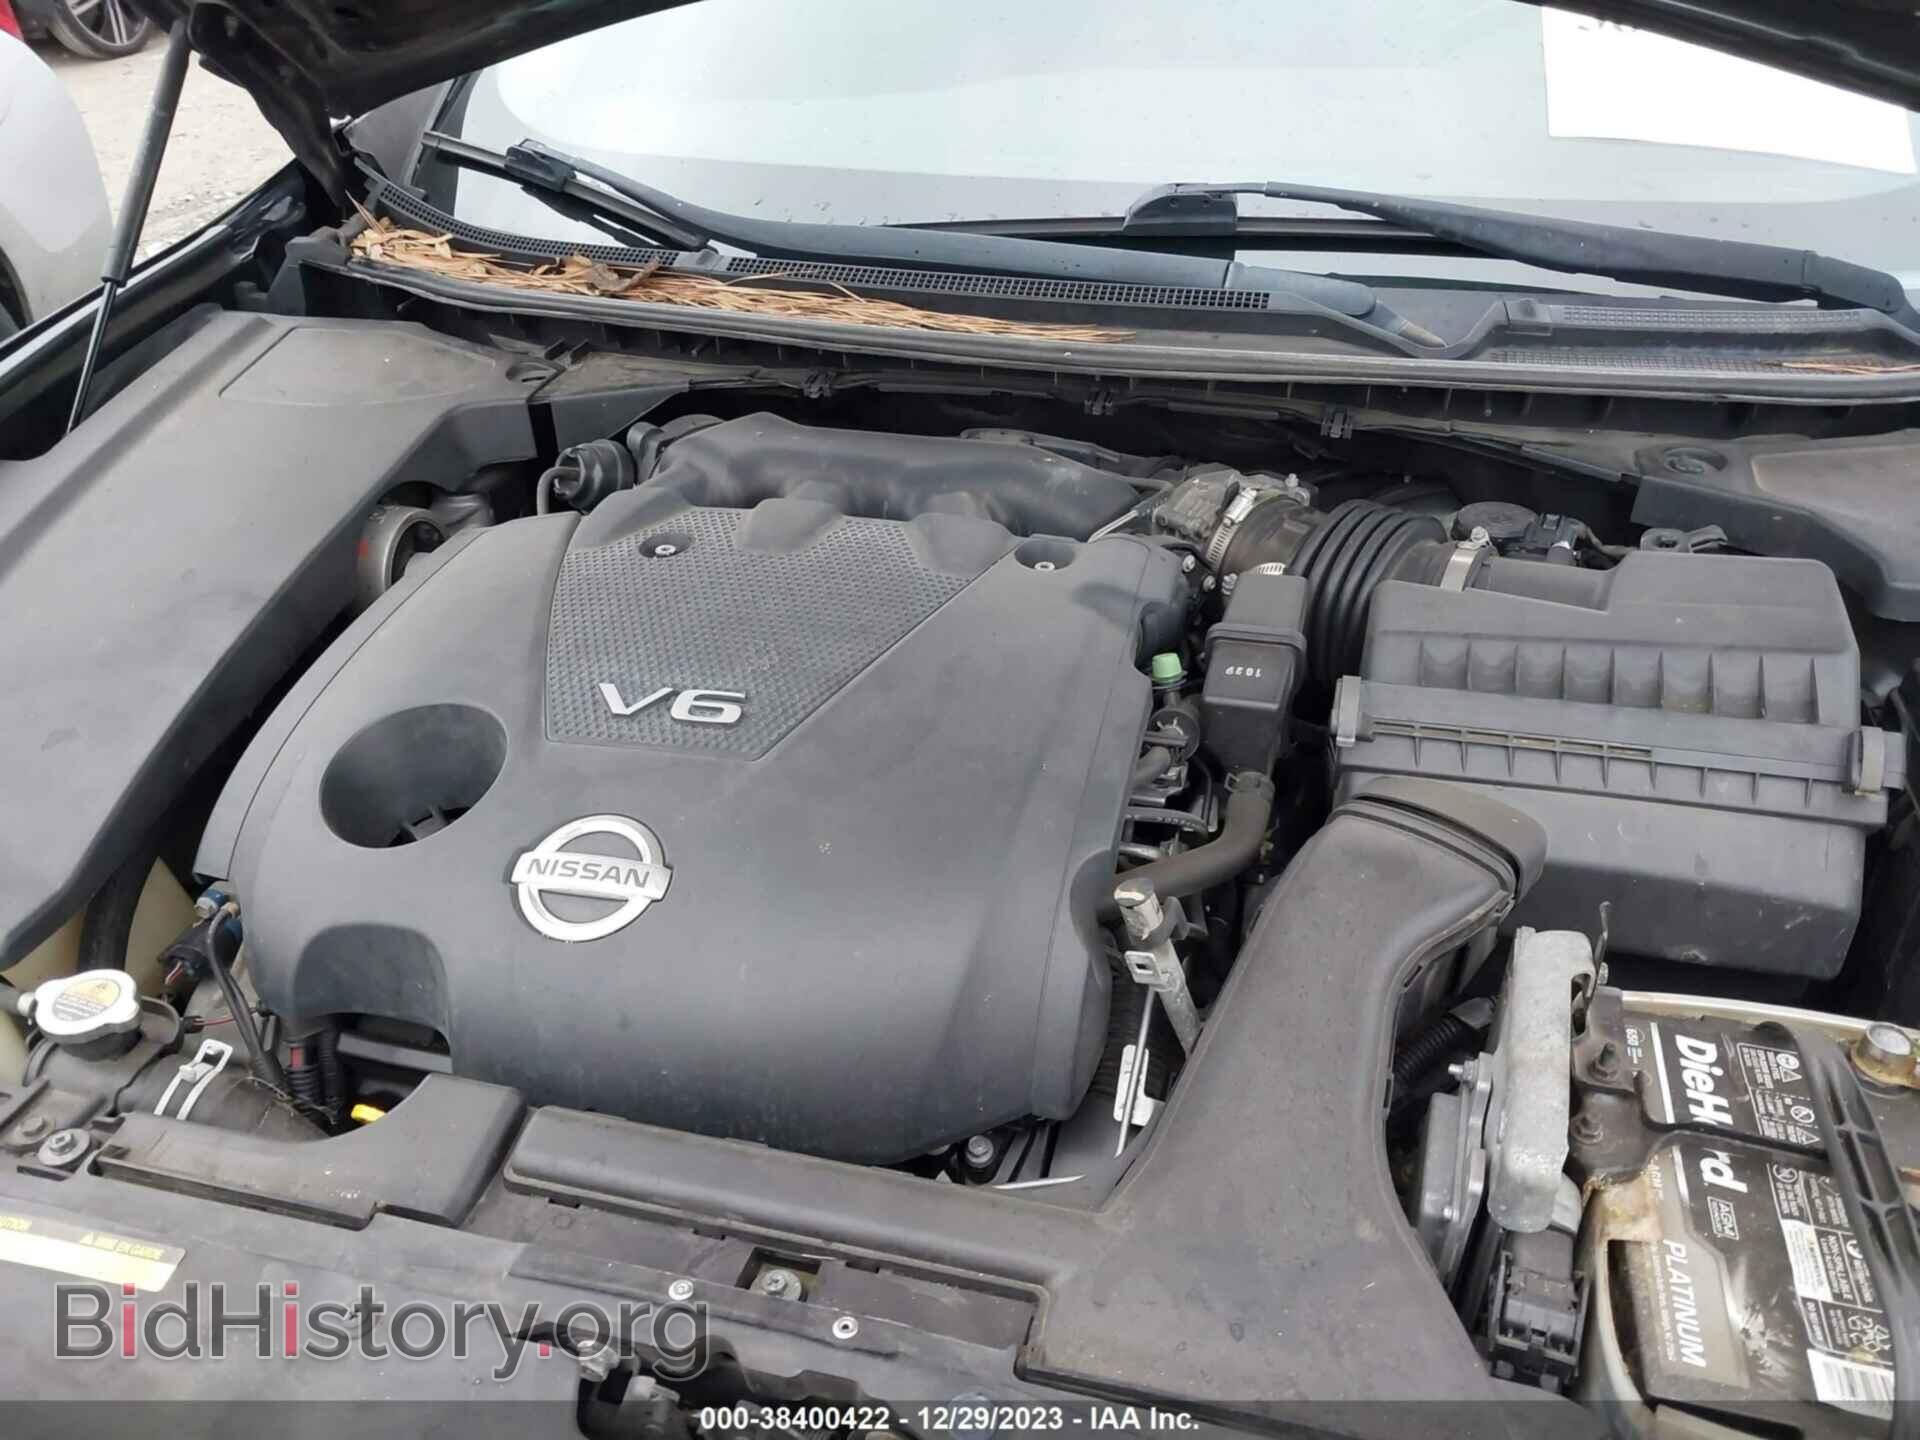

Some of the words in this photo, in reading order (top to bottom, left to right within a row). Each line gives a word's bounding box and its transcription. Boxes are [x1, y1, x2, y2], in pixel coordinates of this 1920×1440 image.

[600, 683, 746, 723] V6
[527, 857, 651, 889] NISSAN
[1663, 1239, 1706, 1368] PLATINUM
